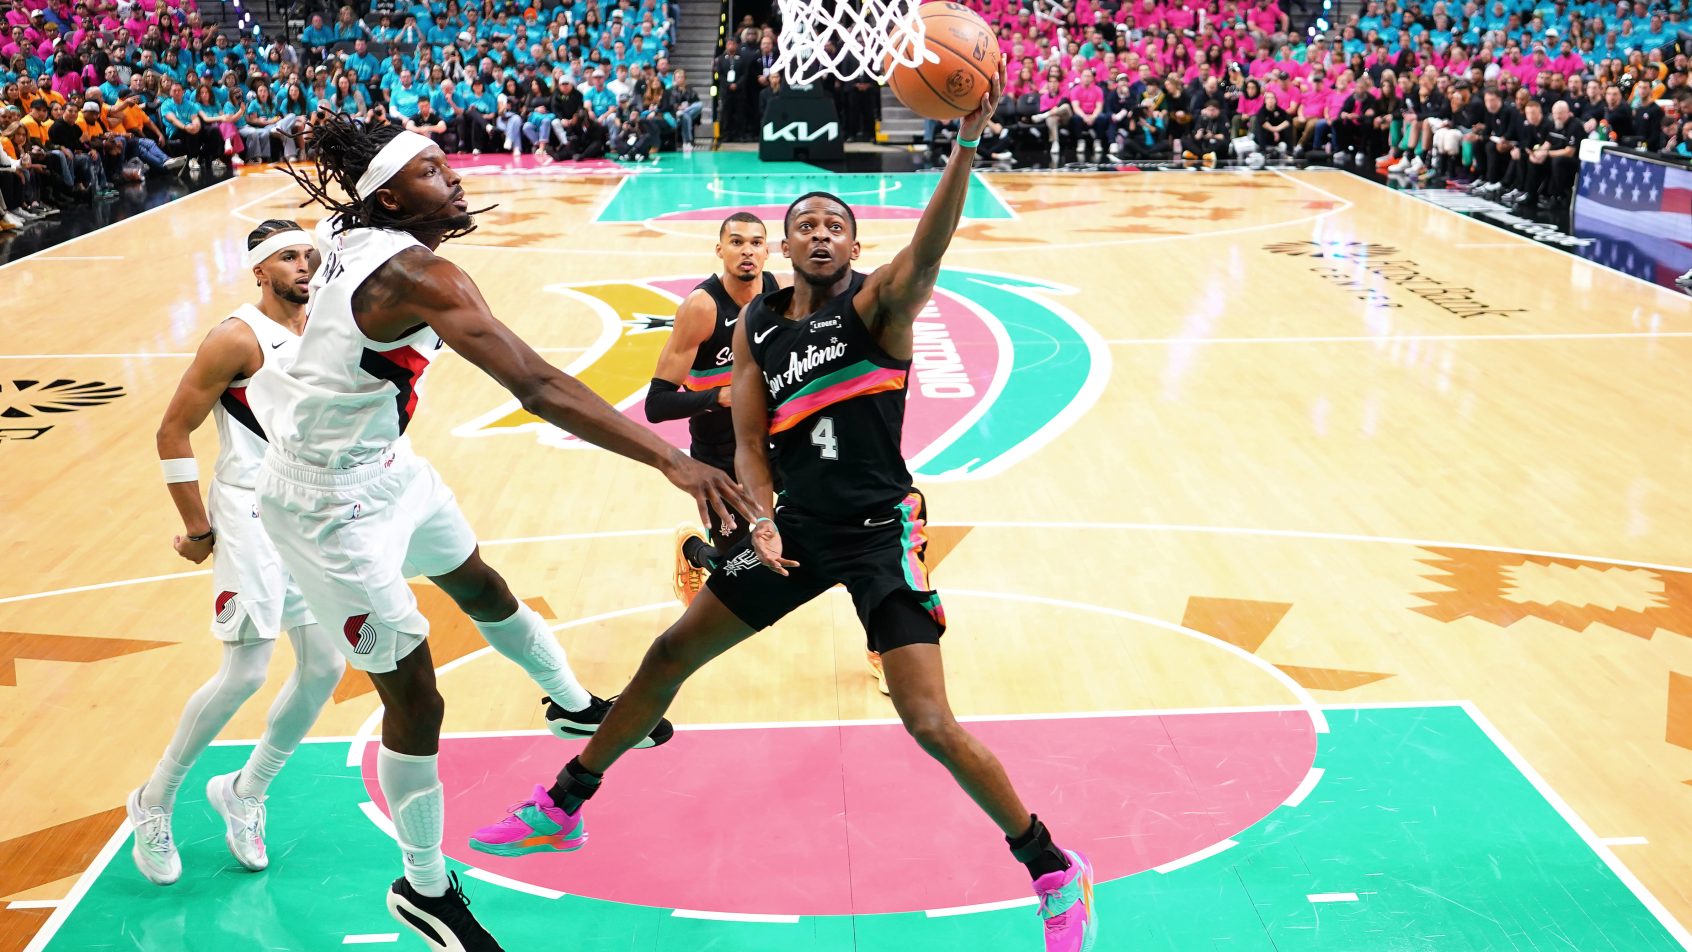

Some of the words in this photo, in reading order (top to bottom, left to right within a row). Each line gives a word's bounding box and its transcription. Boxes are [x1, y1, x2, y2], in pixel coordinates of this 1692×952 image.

[1406, 287, 1528, 318] Bank
[715, 346, 734, 366] Sa
[786, 336, 848, 386] Antonio
[810, 416, 839, 460] 4
